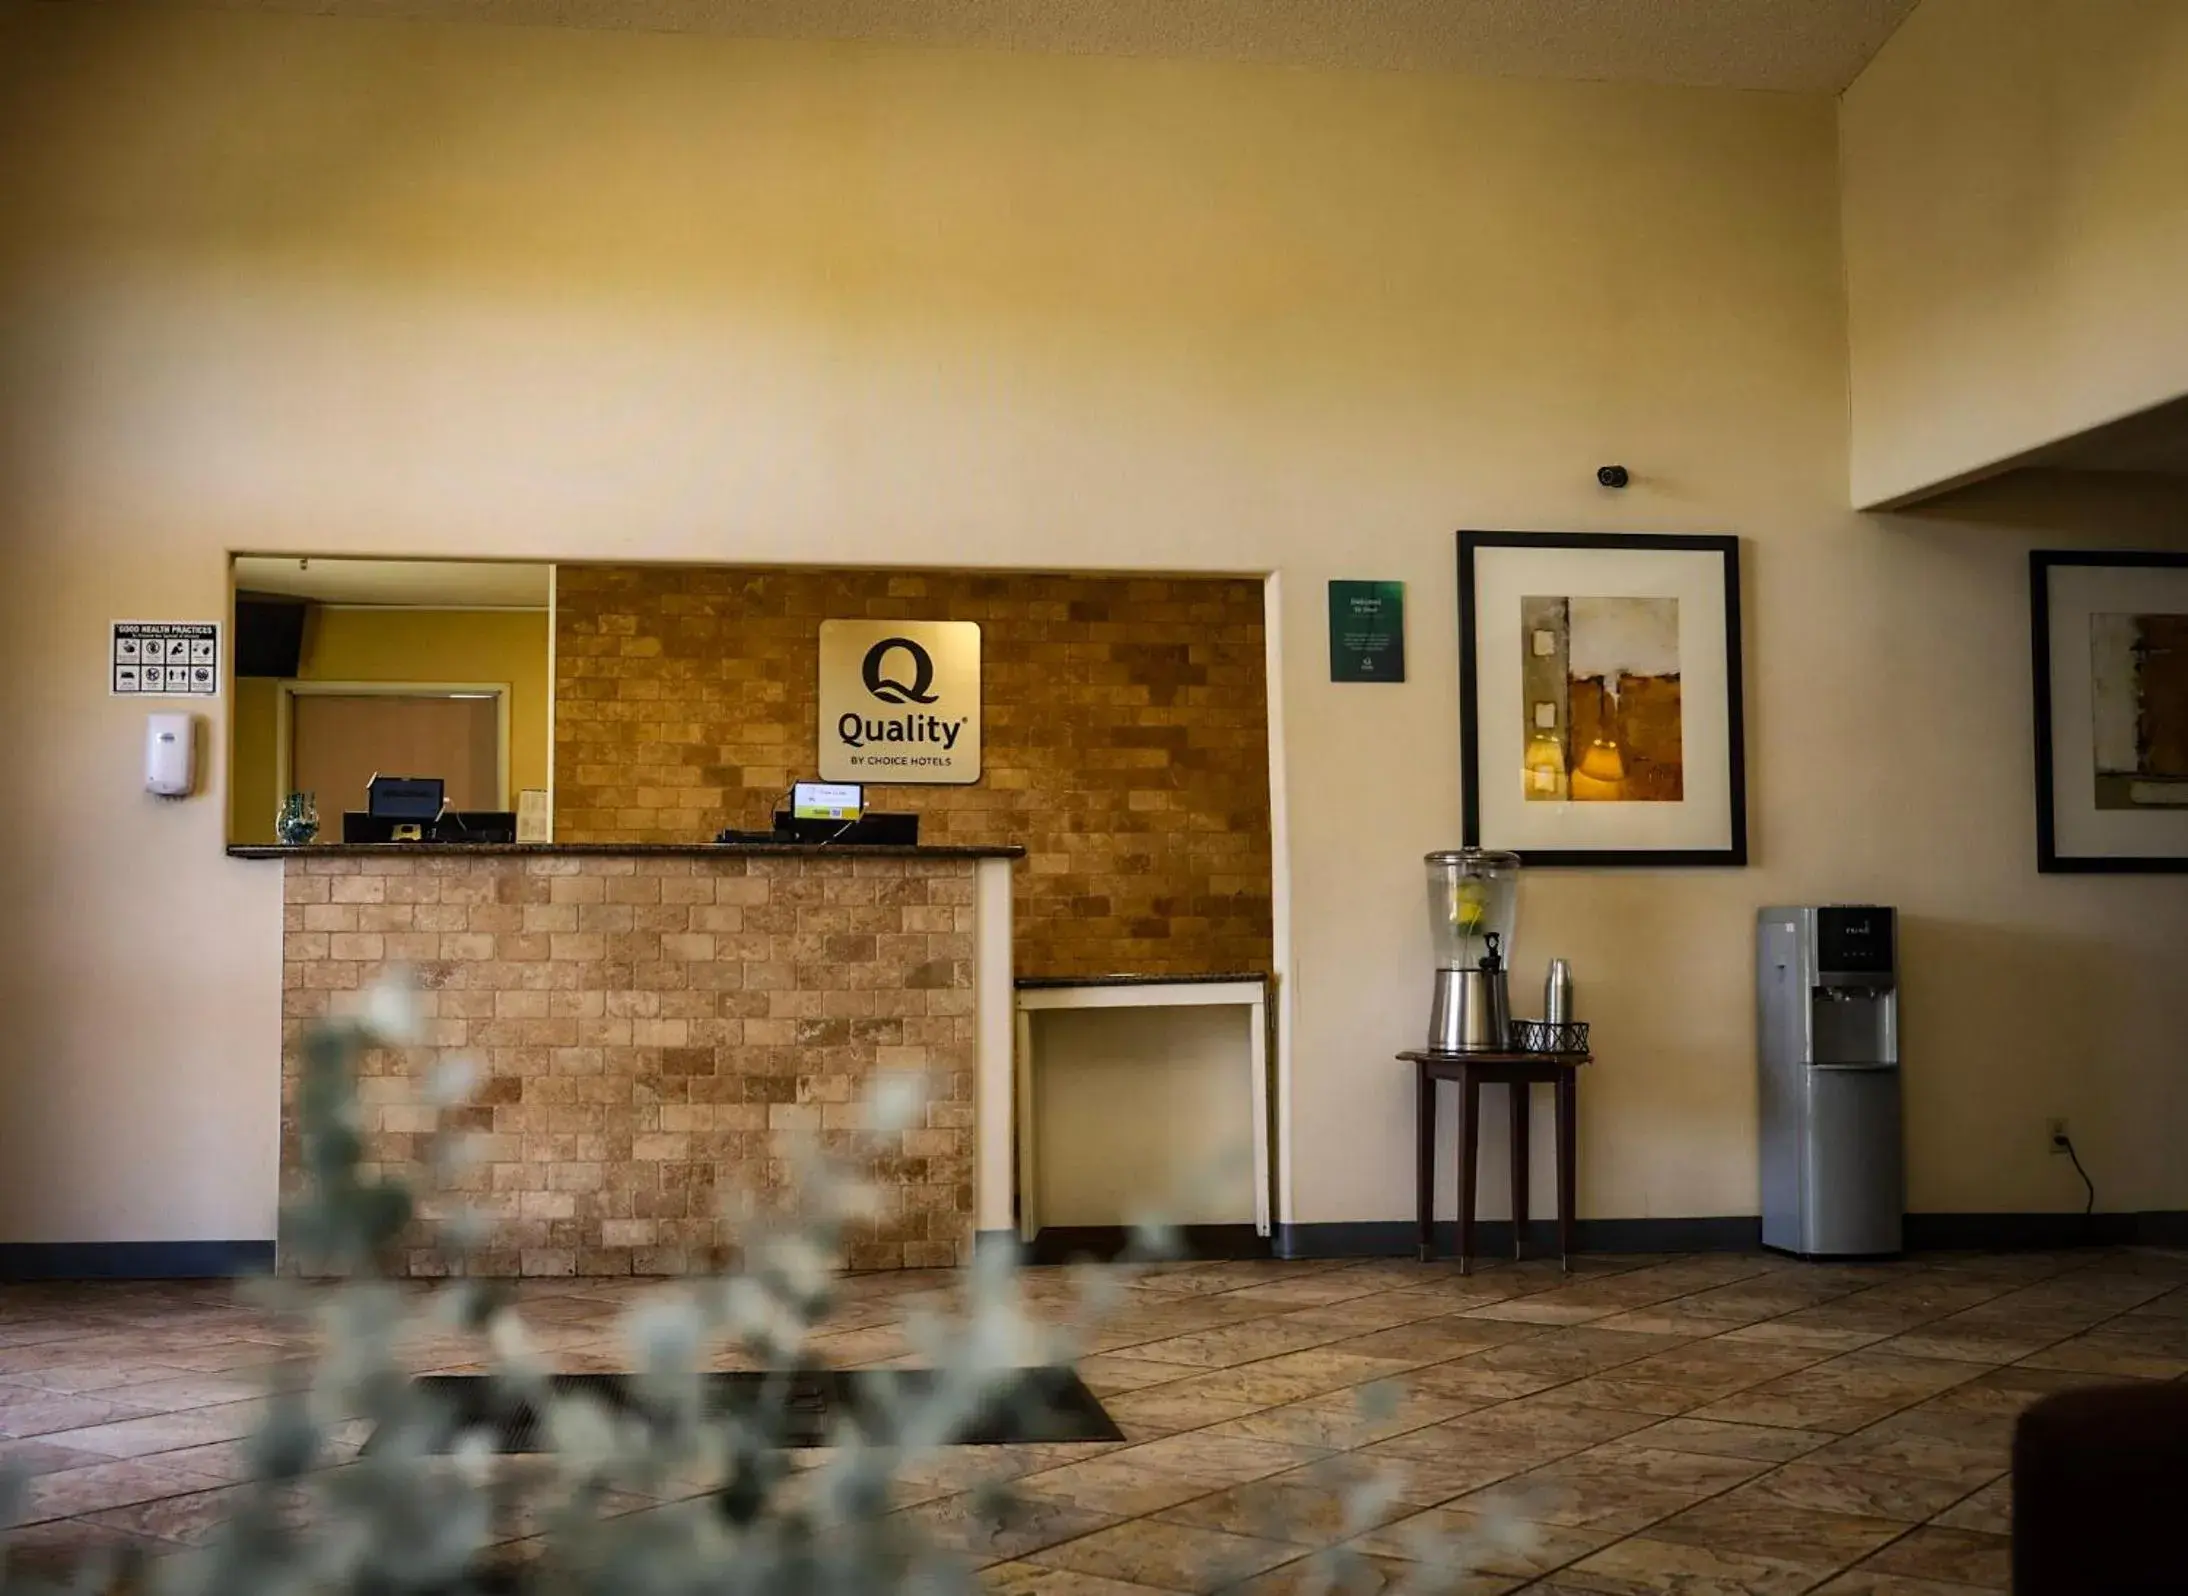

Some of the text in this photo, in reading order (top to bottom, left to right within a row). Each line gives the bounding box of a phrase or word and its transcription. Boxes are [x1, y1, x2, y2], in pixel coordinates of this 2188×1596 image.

[118, 625, 213, 634] GOOD HEALTH PRACTICES
[862, 637, 940, 704] Q
[838, 712, 961, 750] Quality
[851, 756, 953, 767] BY CHOICE HOTELS
